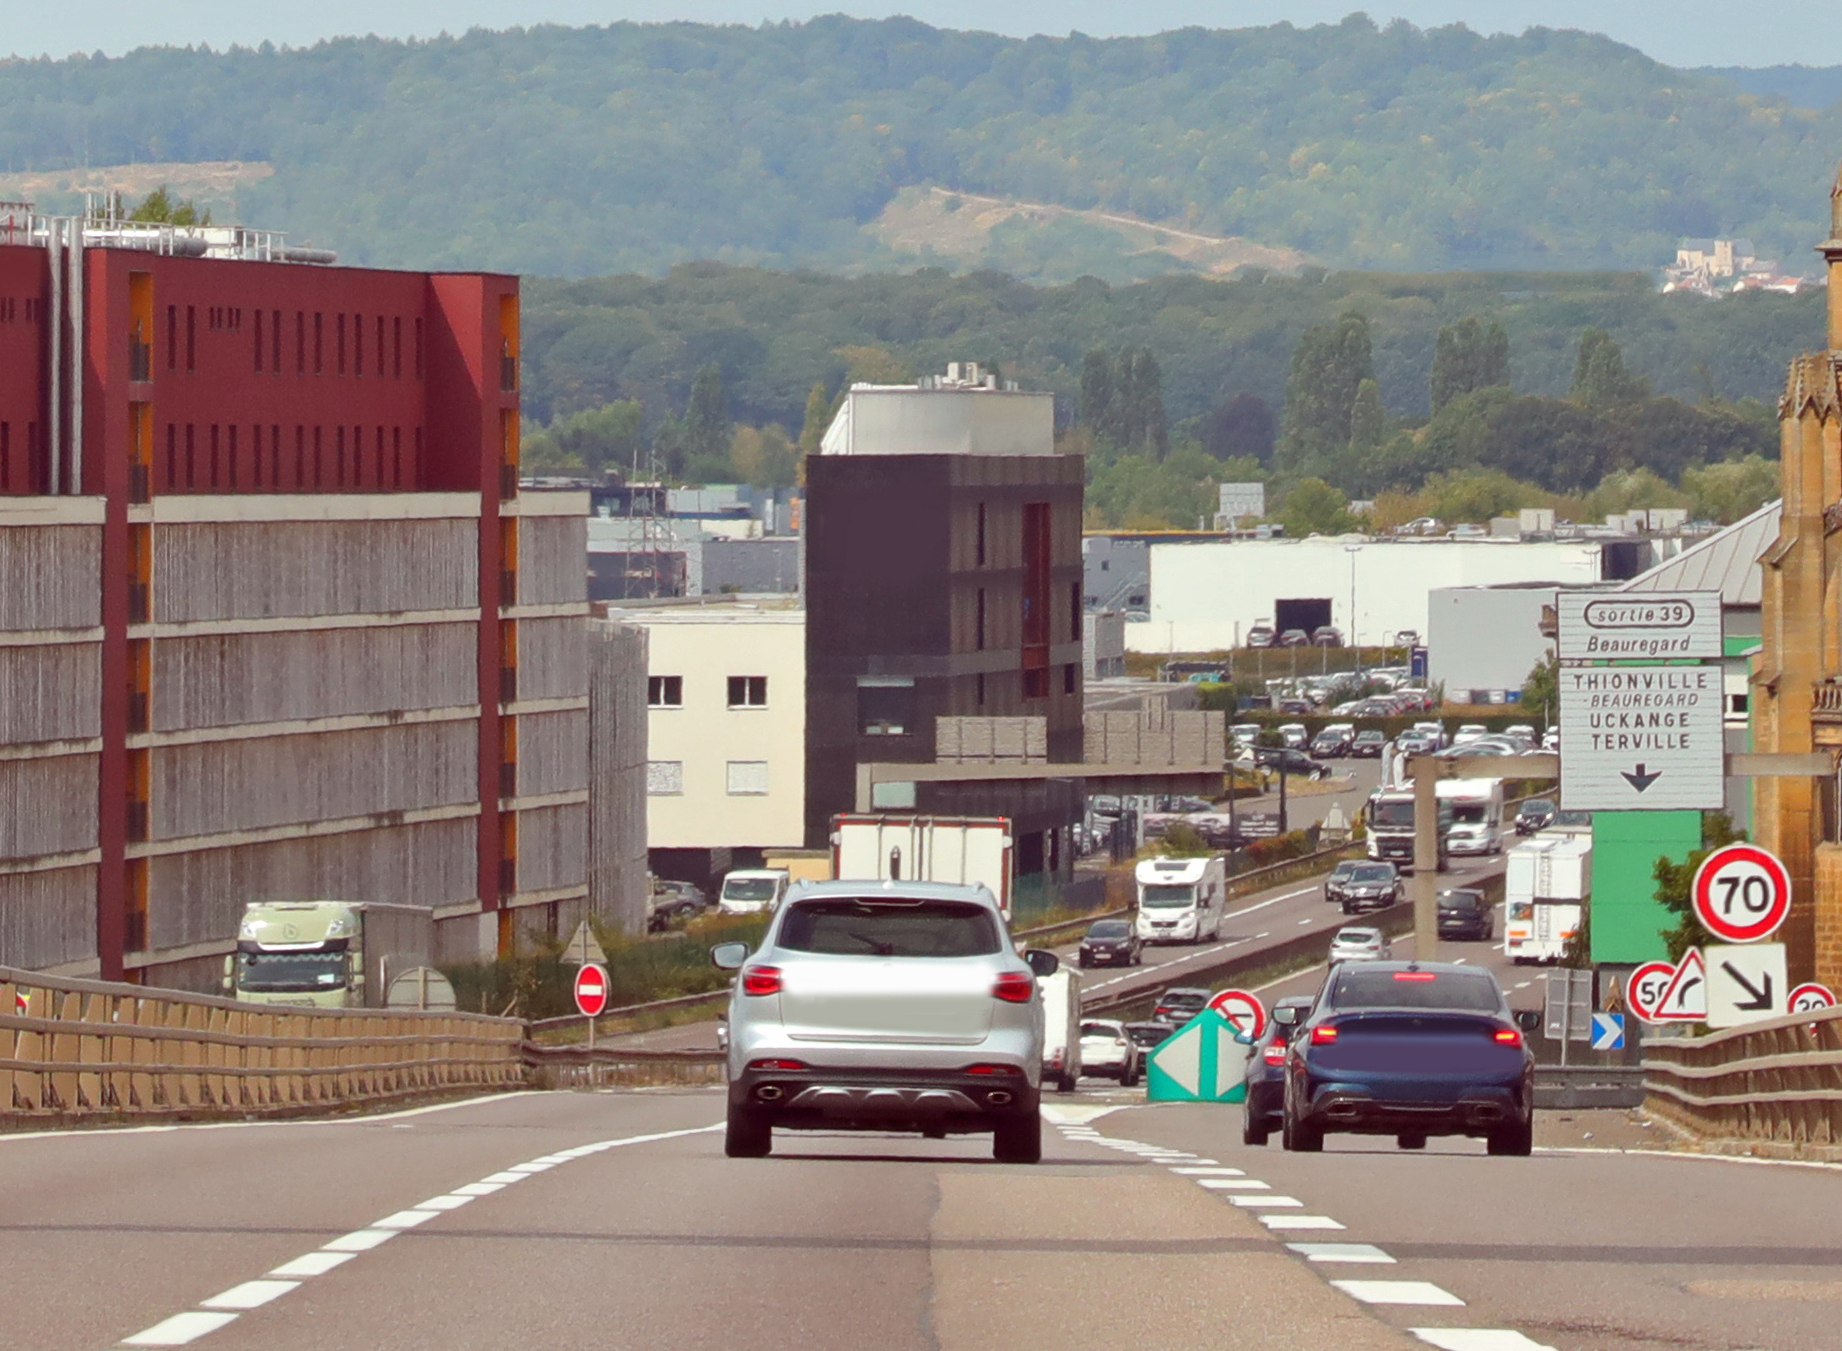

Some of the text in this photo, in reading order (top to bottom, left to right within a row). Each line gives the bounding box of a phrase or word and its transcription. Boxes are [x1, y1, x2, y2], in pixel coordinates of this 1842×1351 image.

[1598, 605, 1684, 622] sortie 39
[1587, 634, 1692, 656] Beauregard
[1573, 672, 1708, 690] THIONVILLE
[1590, 712, 1690, 729] UCKANGE
[1592, 733, 1690, 750] TERVILLE
[1717, 876, 1770, 914] 70
